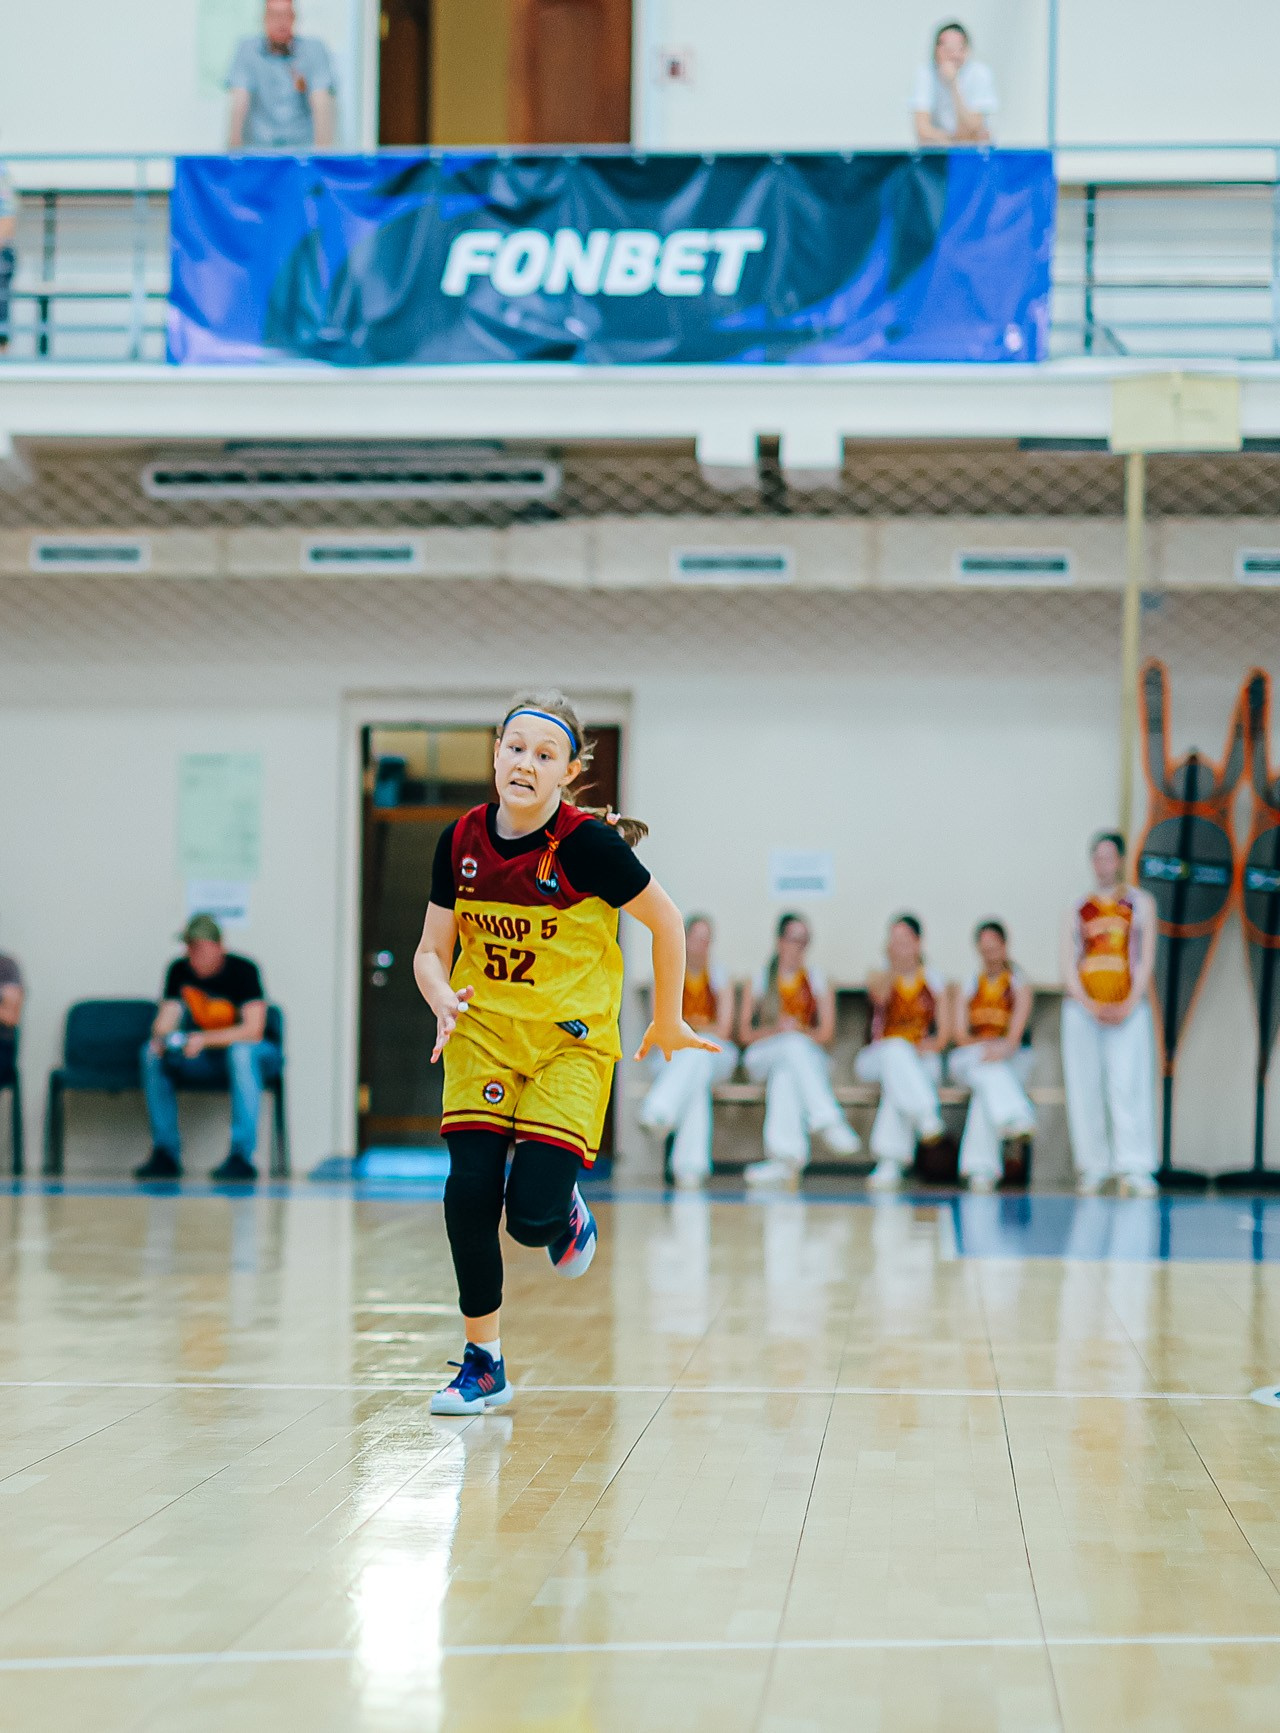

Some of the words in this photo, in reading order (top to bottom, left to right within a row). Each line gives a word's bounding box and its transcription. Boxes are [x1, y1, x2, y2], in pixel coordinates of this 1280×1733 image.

[440, 227, 766, 297] FONBET
[541, 917, 558, 940] 5
[483, 942, 535, 986] 52
